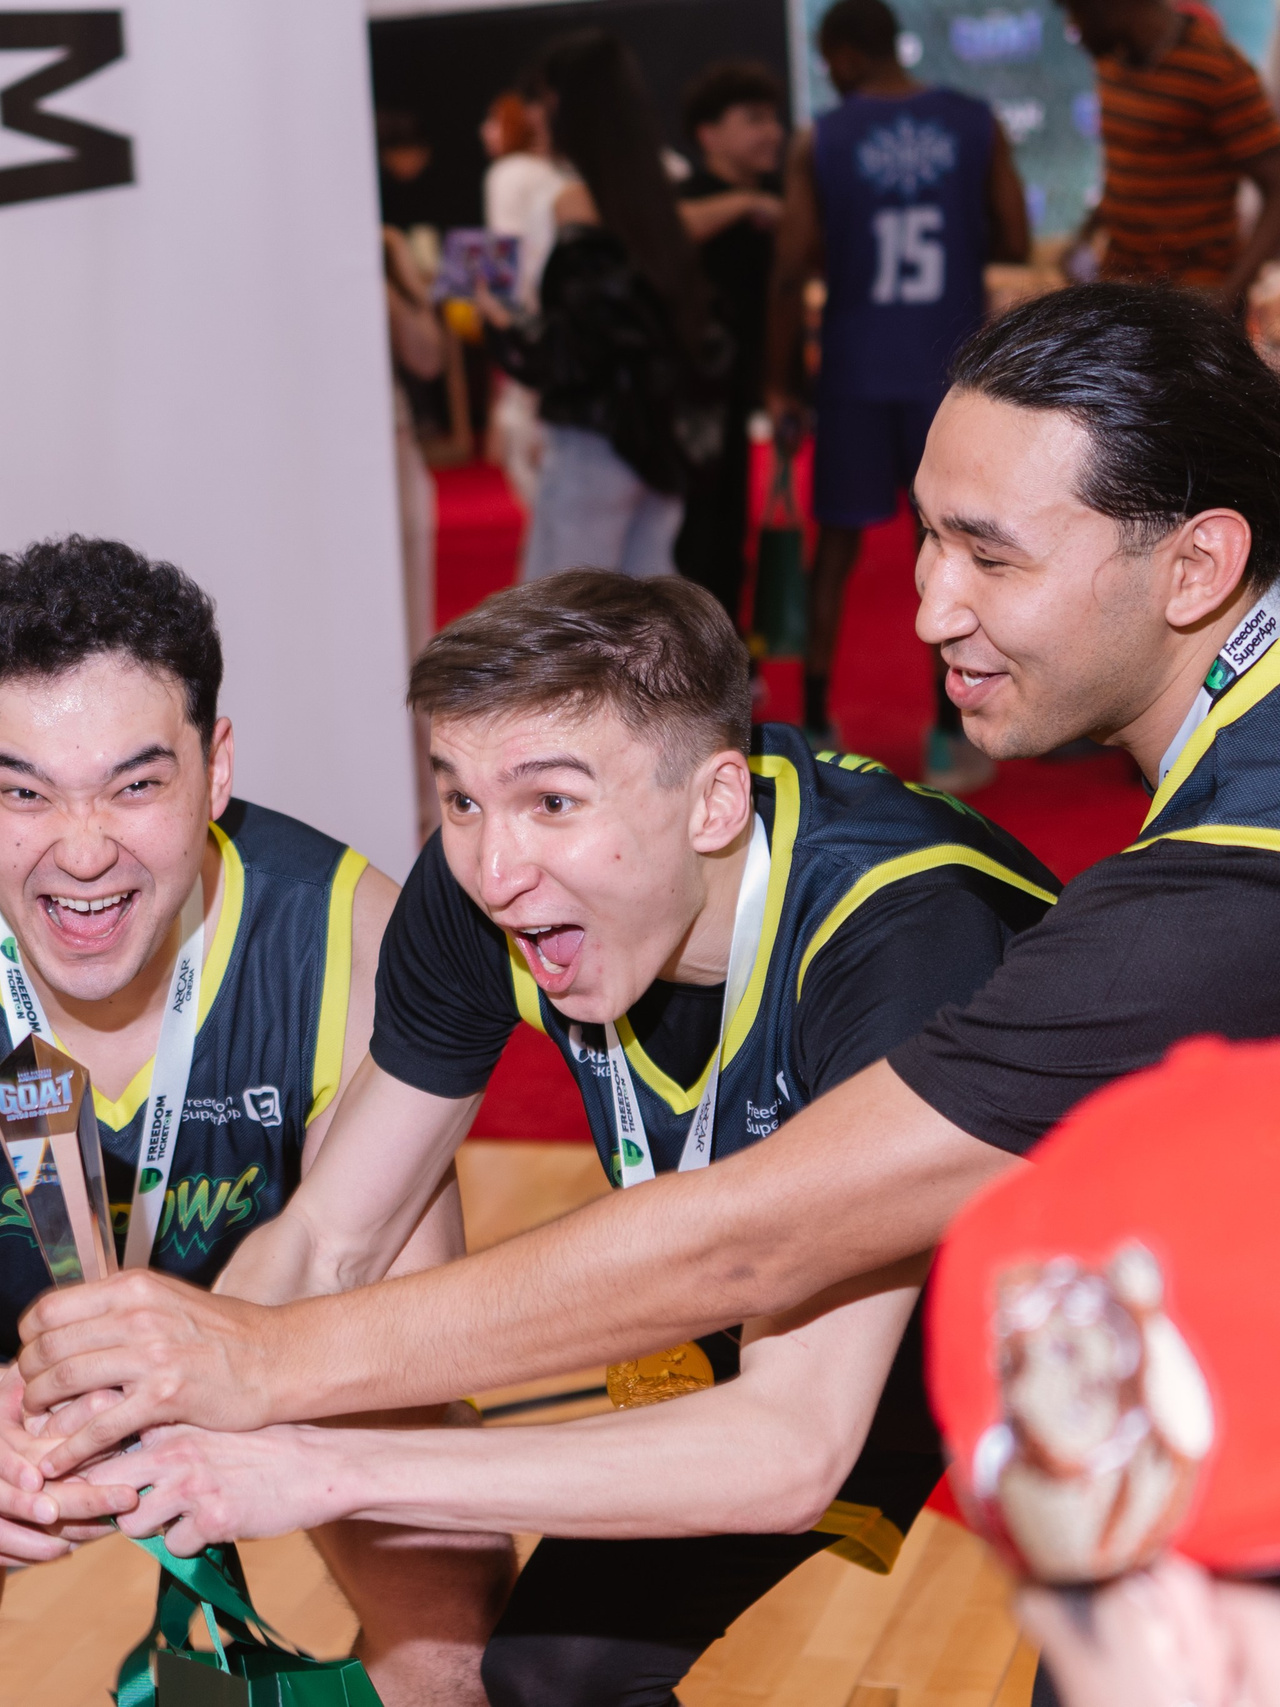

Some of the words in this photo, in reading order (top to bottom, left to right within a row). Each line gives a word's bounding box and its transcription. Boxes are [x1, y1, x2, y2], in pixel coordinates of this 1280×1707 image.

[872, 207, 945, 303] 15
[1223, 609, 1267, 656] Freedom
[1232, 616, 1277, 666] SuperApp
[6, 968, 26, 1020] TICKETON
[13, 968, 42, 1034] FREEDOM
[185, 968, 195, 1001] CINEMA
[613, 1060, 629, 1133] FREEDOM
[146, 1094, 167, 1163] FREEDOM
[157, 1109, 173, 1161] TICKETON
